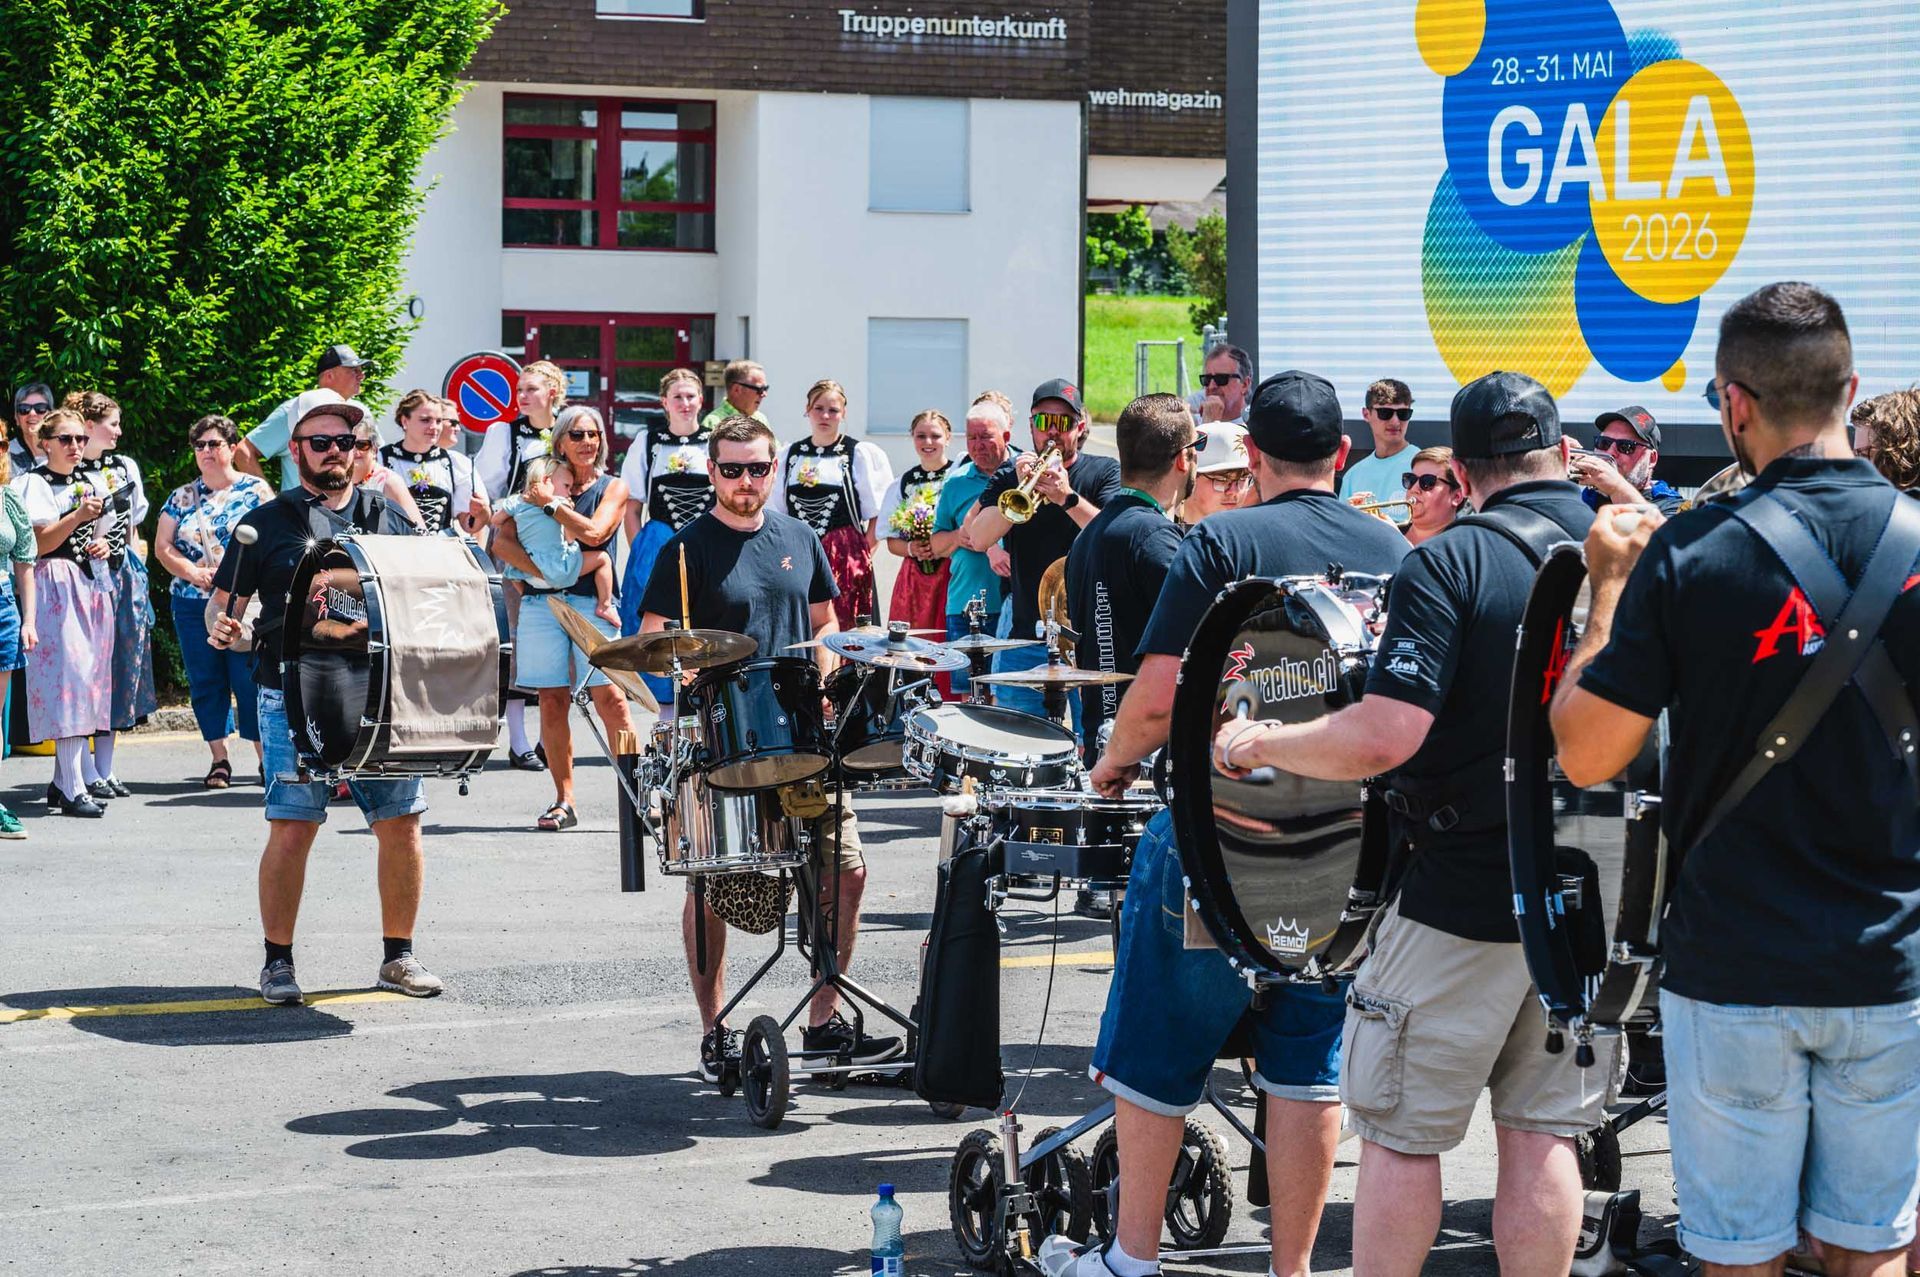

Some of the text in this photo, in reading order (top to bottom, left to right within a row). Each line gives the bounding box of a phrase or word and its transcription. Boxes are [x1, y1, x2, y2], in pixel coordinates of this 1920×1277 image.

[838, 10, 1067, 40] Truppenunterkunft
[1491, 49, 1613, 85] 28.-31. MAI
[1087, 87, 1222, 111] wehrmagazin
[1487, 95, 1732, 206] GALA
[1622, 212, 1718, 262] 2026
[1249, 648, 1337, 704] vaelue.ch
[1272, 934, 1304, 949] REMO
